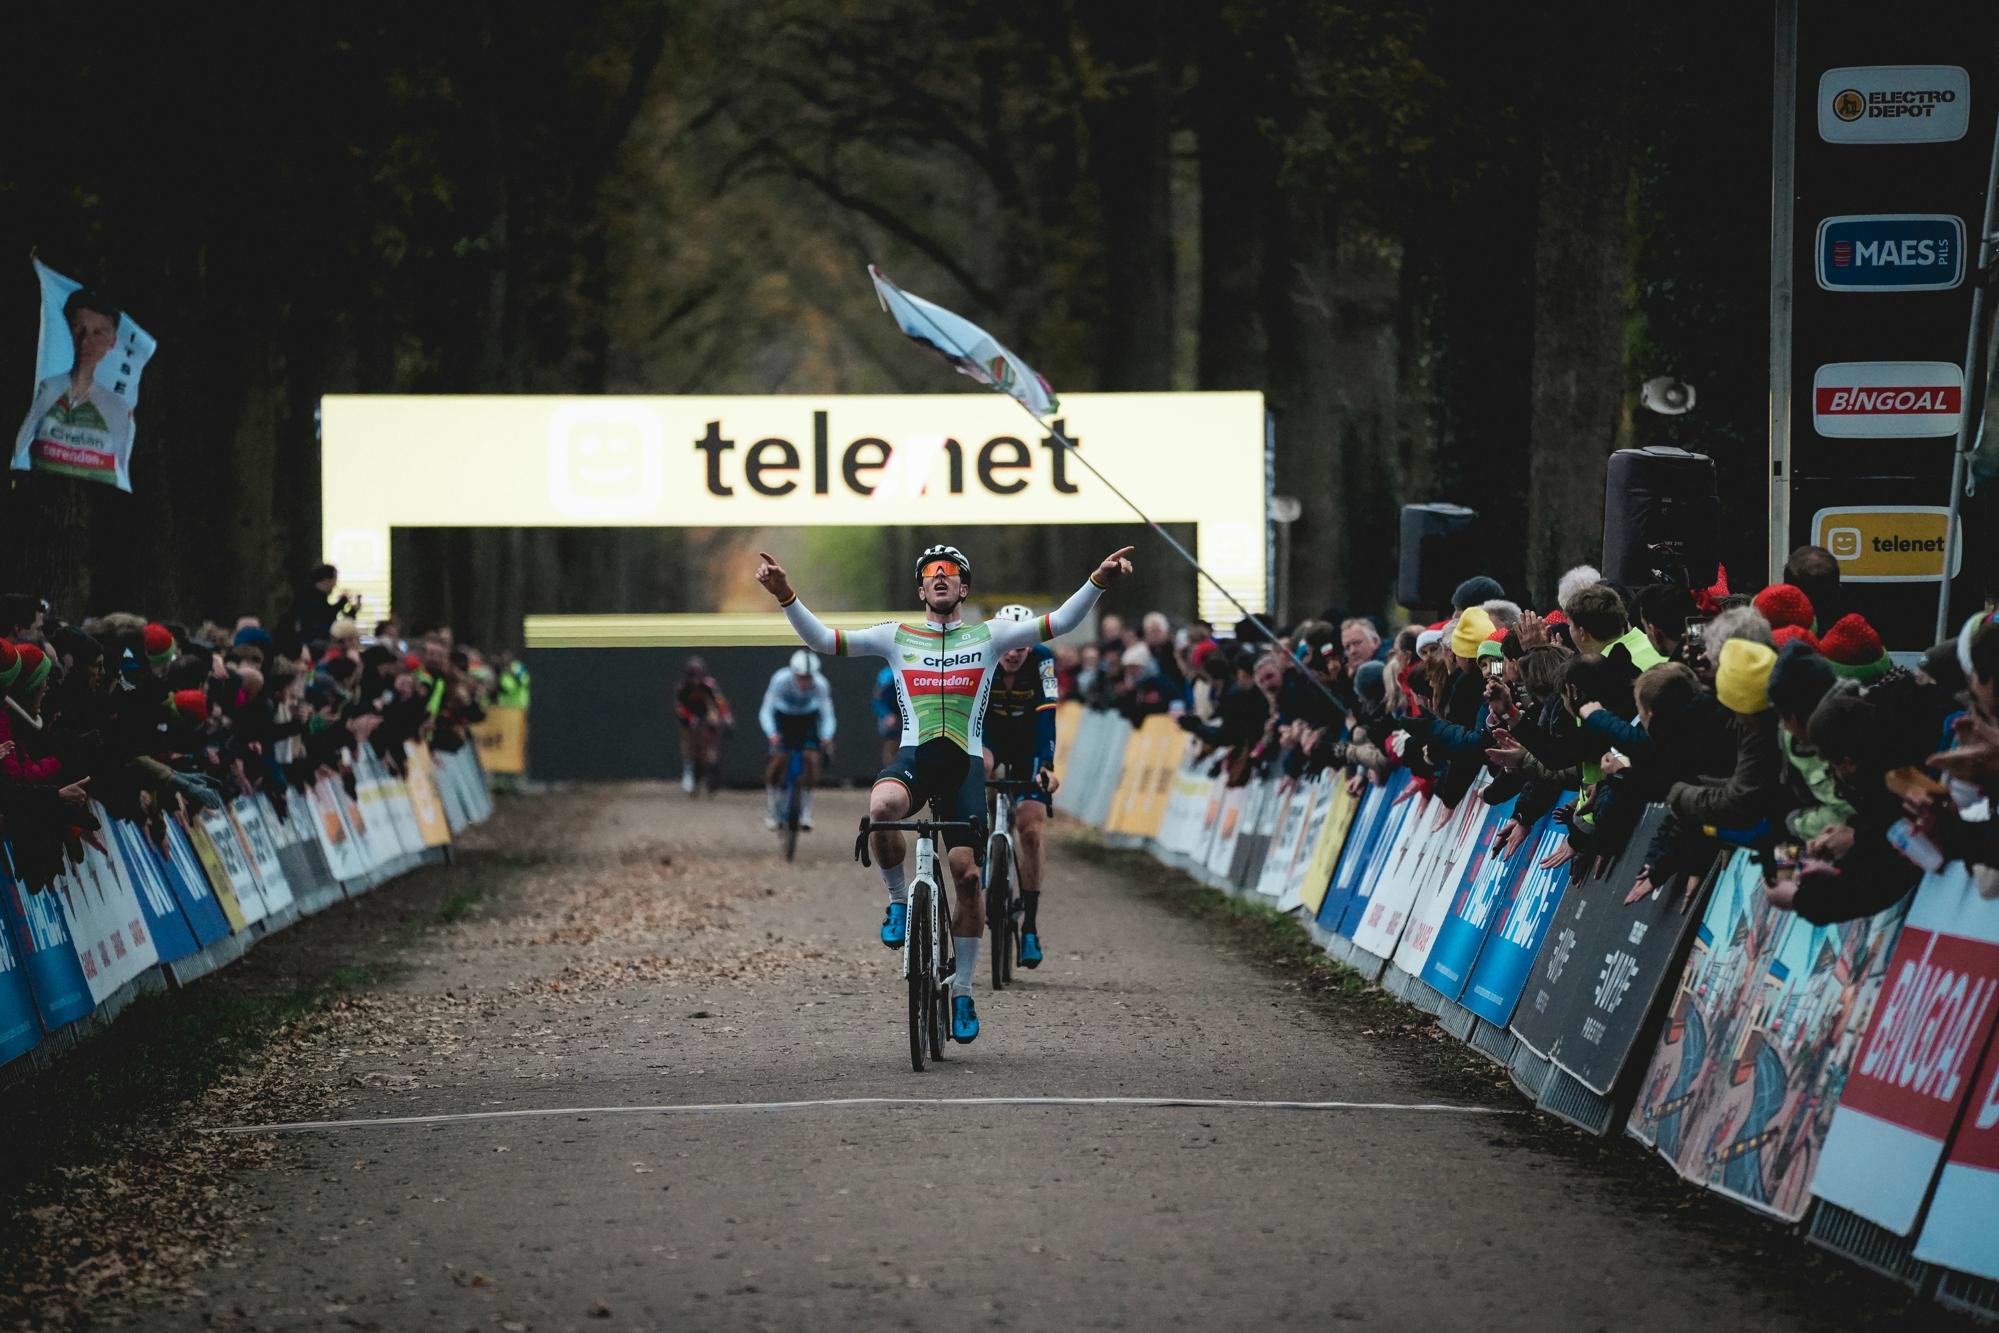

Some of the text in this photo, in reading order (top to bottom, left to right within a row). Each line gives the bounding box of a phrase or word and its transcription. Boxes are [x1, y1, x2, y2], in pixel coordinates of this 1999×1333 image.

[1868, 90, 1956, 105] ELECTRO
[1868, 105, 1935, 118] DEPOT
[1855, 240, 1936, 266] MAES
[1938, 239, 1949, 265] PILS
[1872, 535, 1944, 553] telenet
[923, 651, 982, 668] crelan
